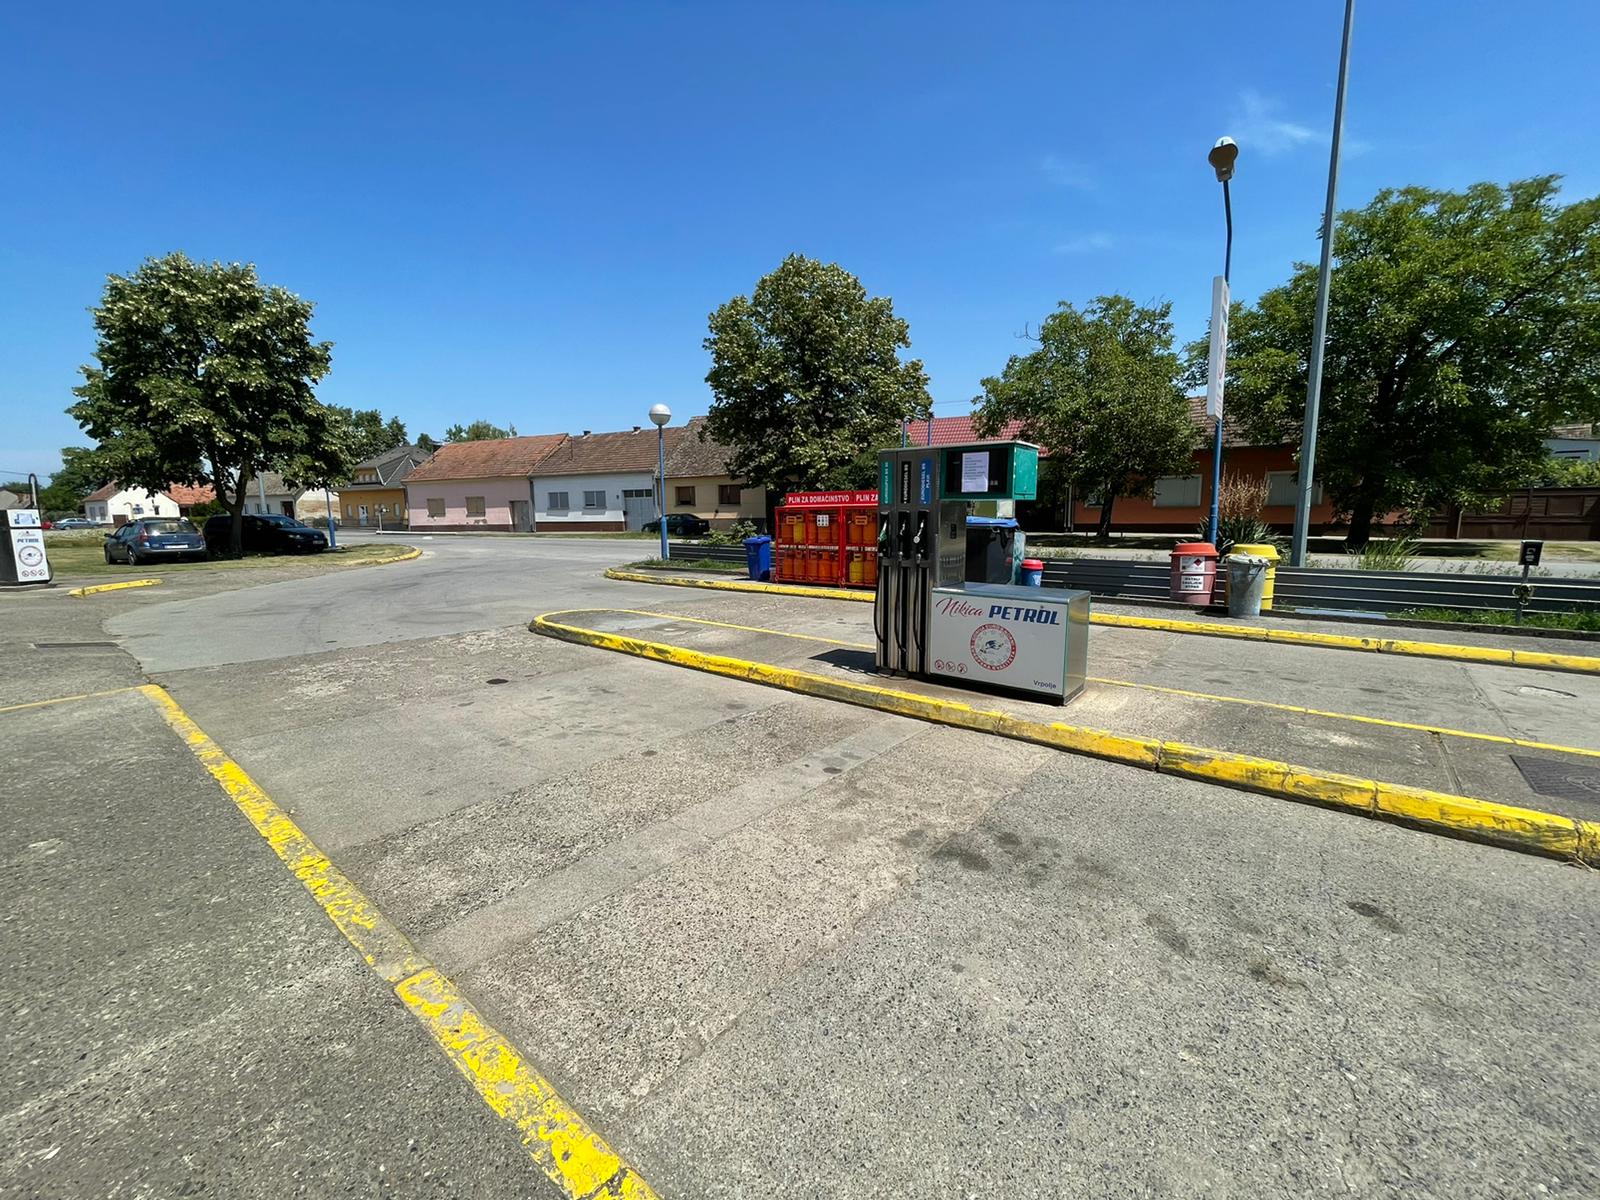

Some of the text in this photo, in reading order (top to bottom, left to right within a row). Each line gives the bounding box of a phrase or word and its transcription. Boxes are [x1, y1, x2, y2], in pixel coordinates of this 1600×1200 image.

[855, 494, 870, 502] PLIN
[935, 597, 1060, 625] Nikica PETROL
[1033, 680, 1057, 689] Vrpolje
